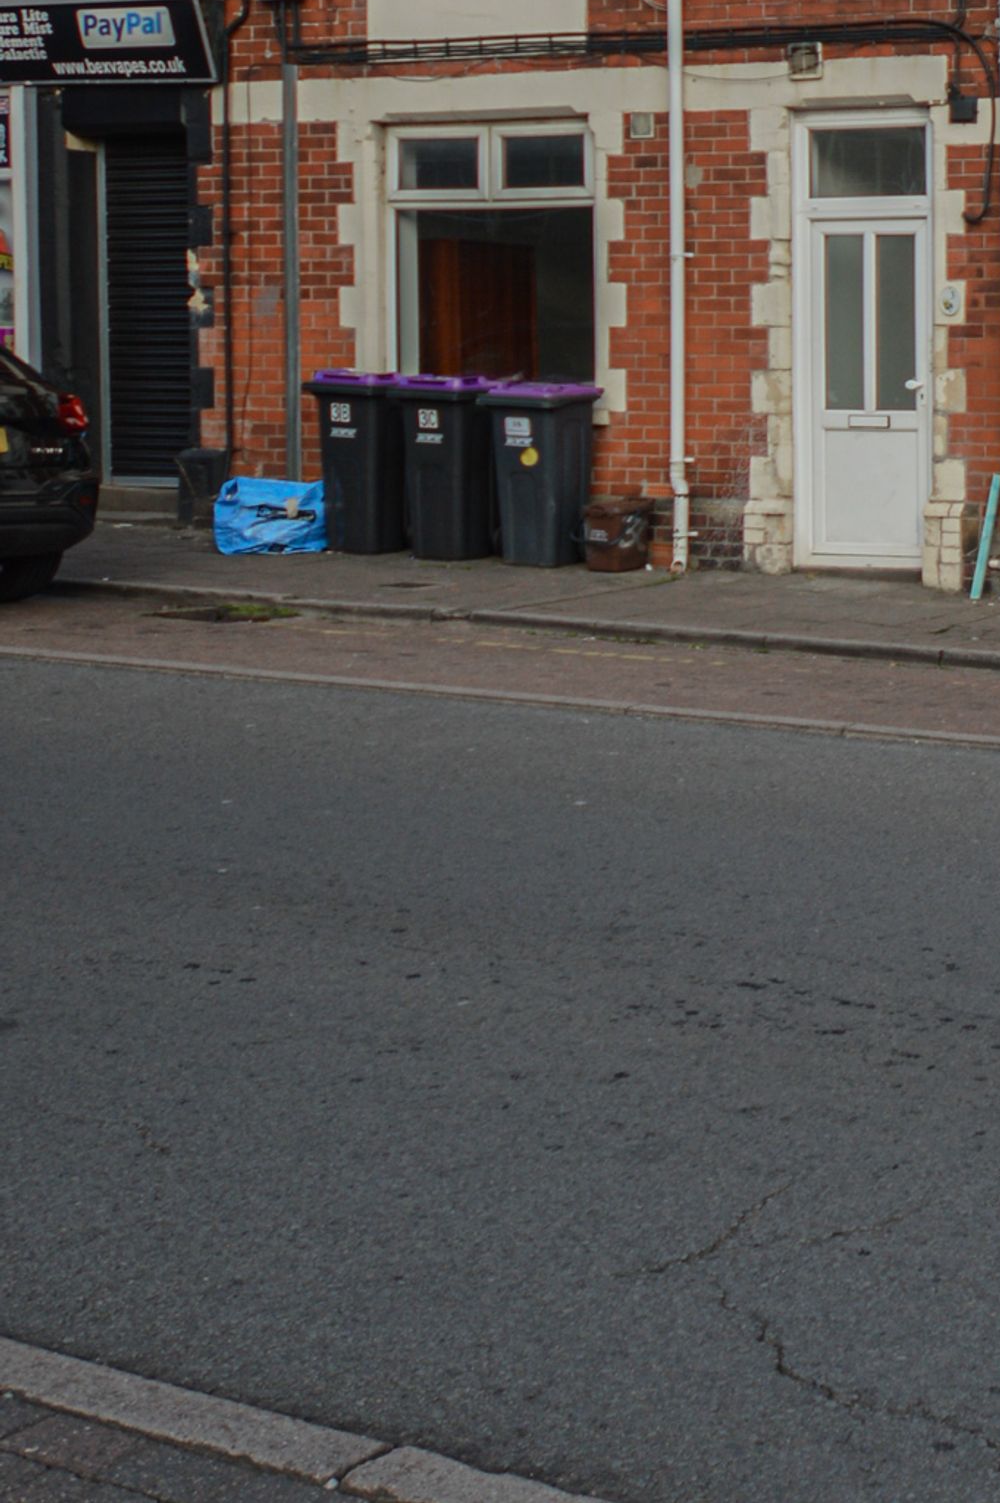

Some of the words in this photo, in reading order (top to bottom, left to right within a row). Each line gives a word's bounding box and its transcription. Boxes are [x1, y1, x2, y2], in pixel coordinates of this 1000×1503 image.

[20, 8, 49, 22] Lite
[22, 22, 54, 35] Mist
[83, 12, 162, 42] PayPal
[53, 56, 187, 77] www.bexvapes.co.uk
[331, 403, 350, 421] 3B
